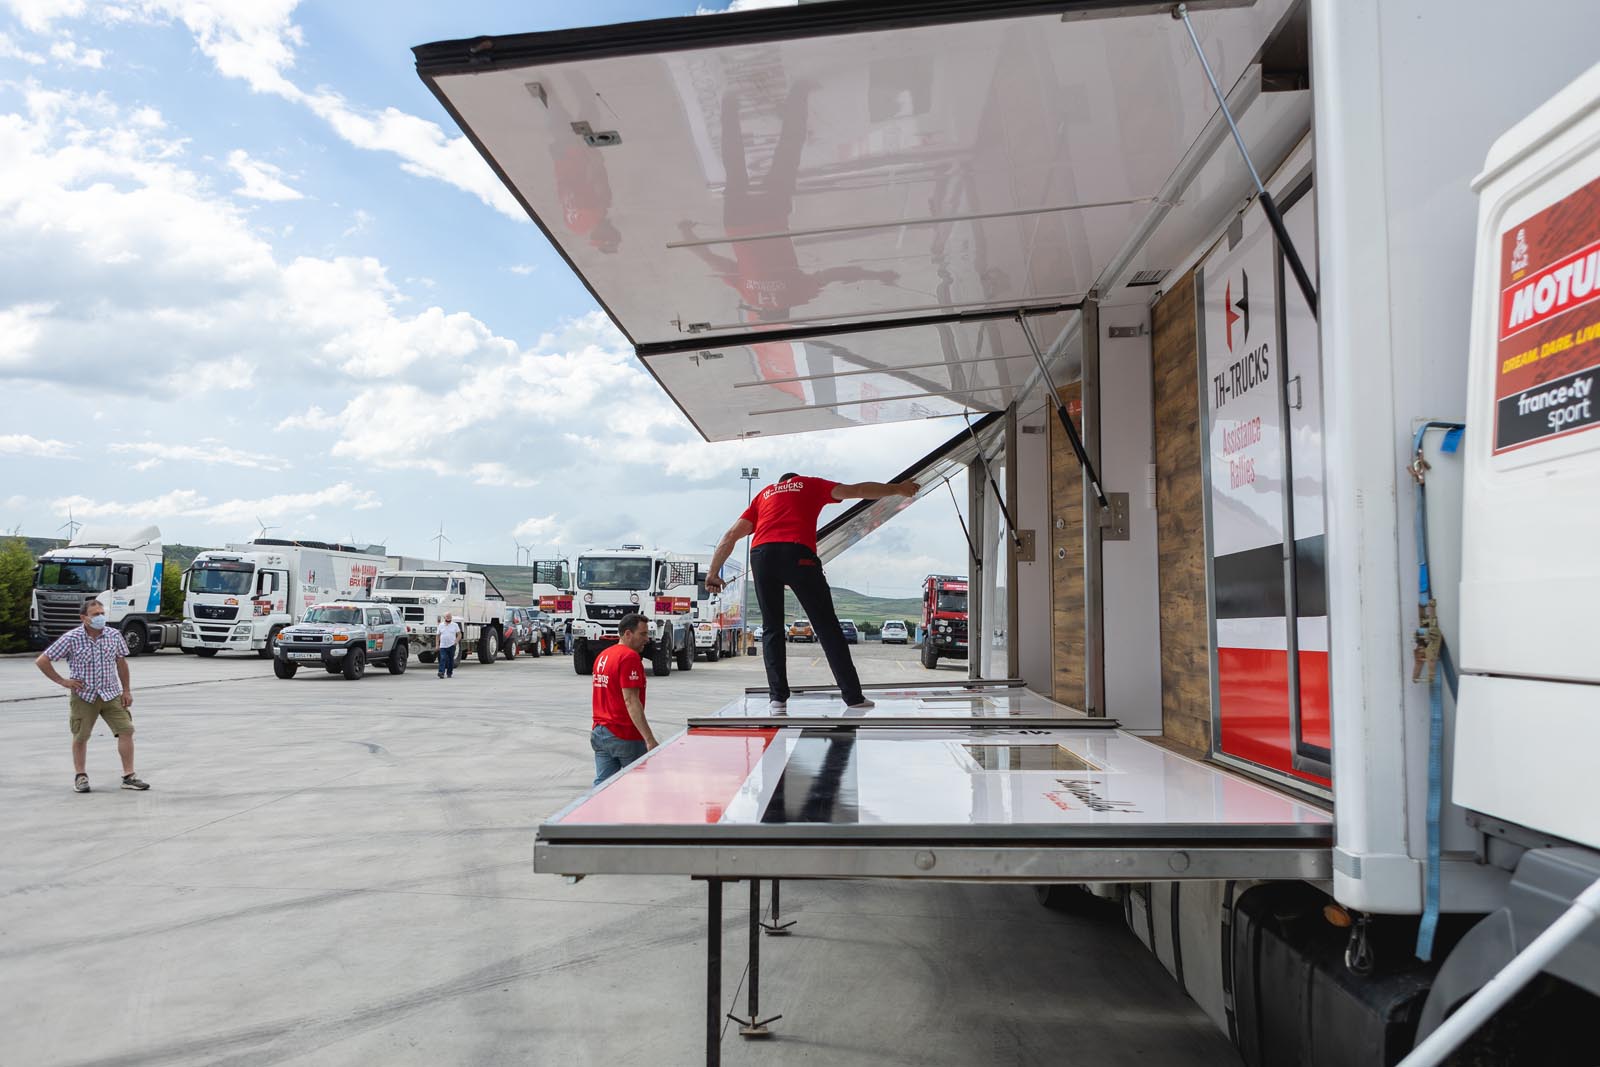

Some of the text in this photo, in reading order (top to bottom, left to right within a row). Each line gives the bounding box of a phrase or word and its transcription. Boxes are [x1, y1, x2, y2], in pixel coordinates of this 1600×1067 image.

[1213, 343, 1269, 409] TH-TRUCKS
[1547, 398, 1592, 433] sport
[1222, 416, 1261, 457] Assistance
[1230, 457, 1256, 490] Rallies
